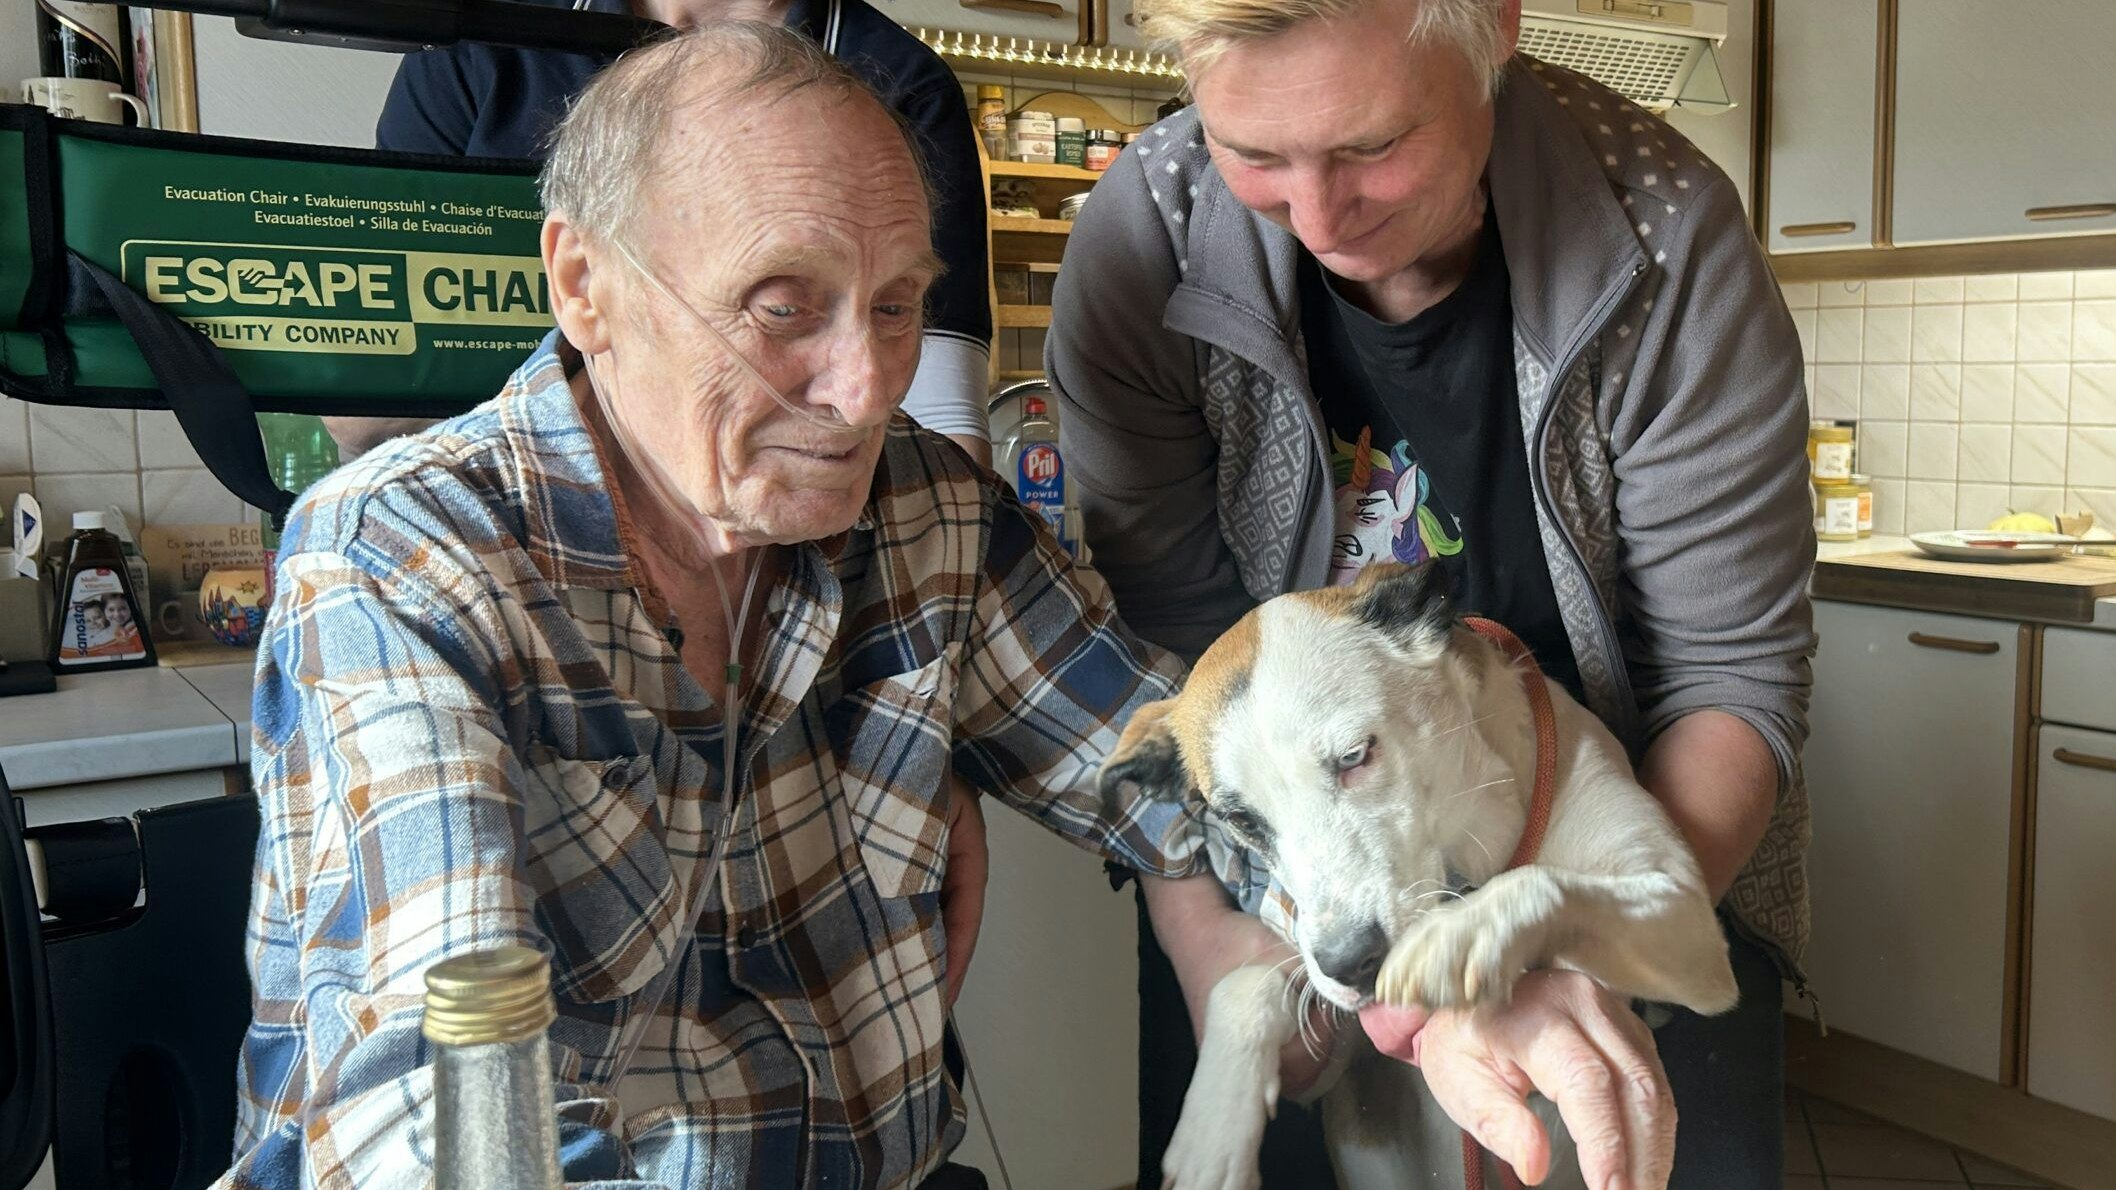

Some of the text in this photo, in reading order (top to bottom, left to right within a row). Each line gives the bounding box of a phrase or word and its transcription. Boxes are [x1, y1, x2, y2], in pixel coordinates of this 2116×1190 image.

[165, 186, 245, 202] Evacuation
[250, 190, 288, 205] Chair
[305, 193, 425, 213] Evakuierungsstuhl
[441, 202, 483, 217] Chaise
[254, 211, 492, 235] Evacuatiestoel Silla de Evacuación
[145, 256, 395, 309] ESCAPE
[189, 321, 399, 345] BILITY COMPANY
[1028, 453, 1056, 478] Pril
[1026, 491, 1058, 499] POWER
[72, 601, 88, 656] sanostal
